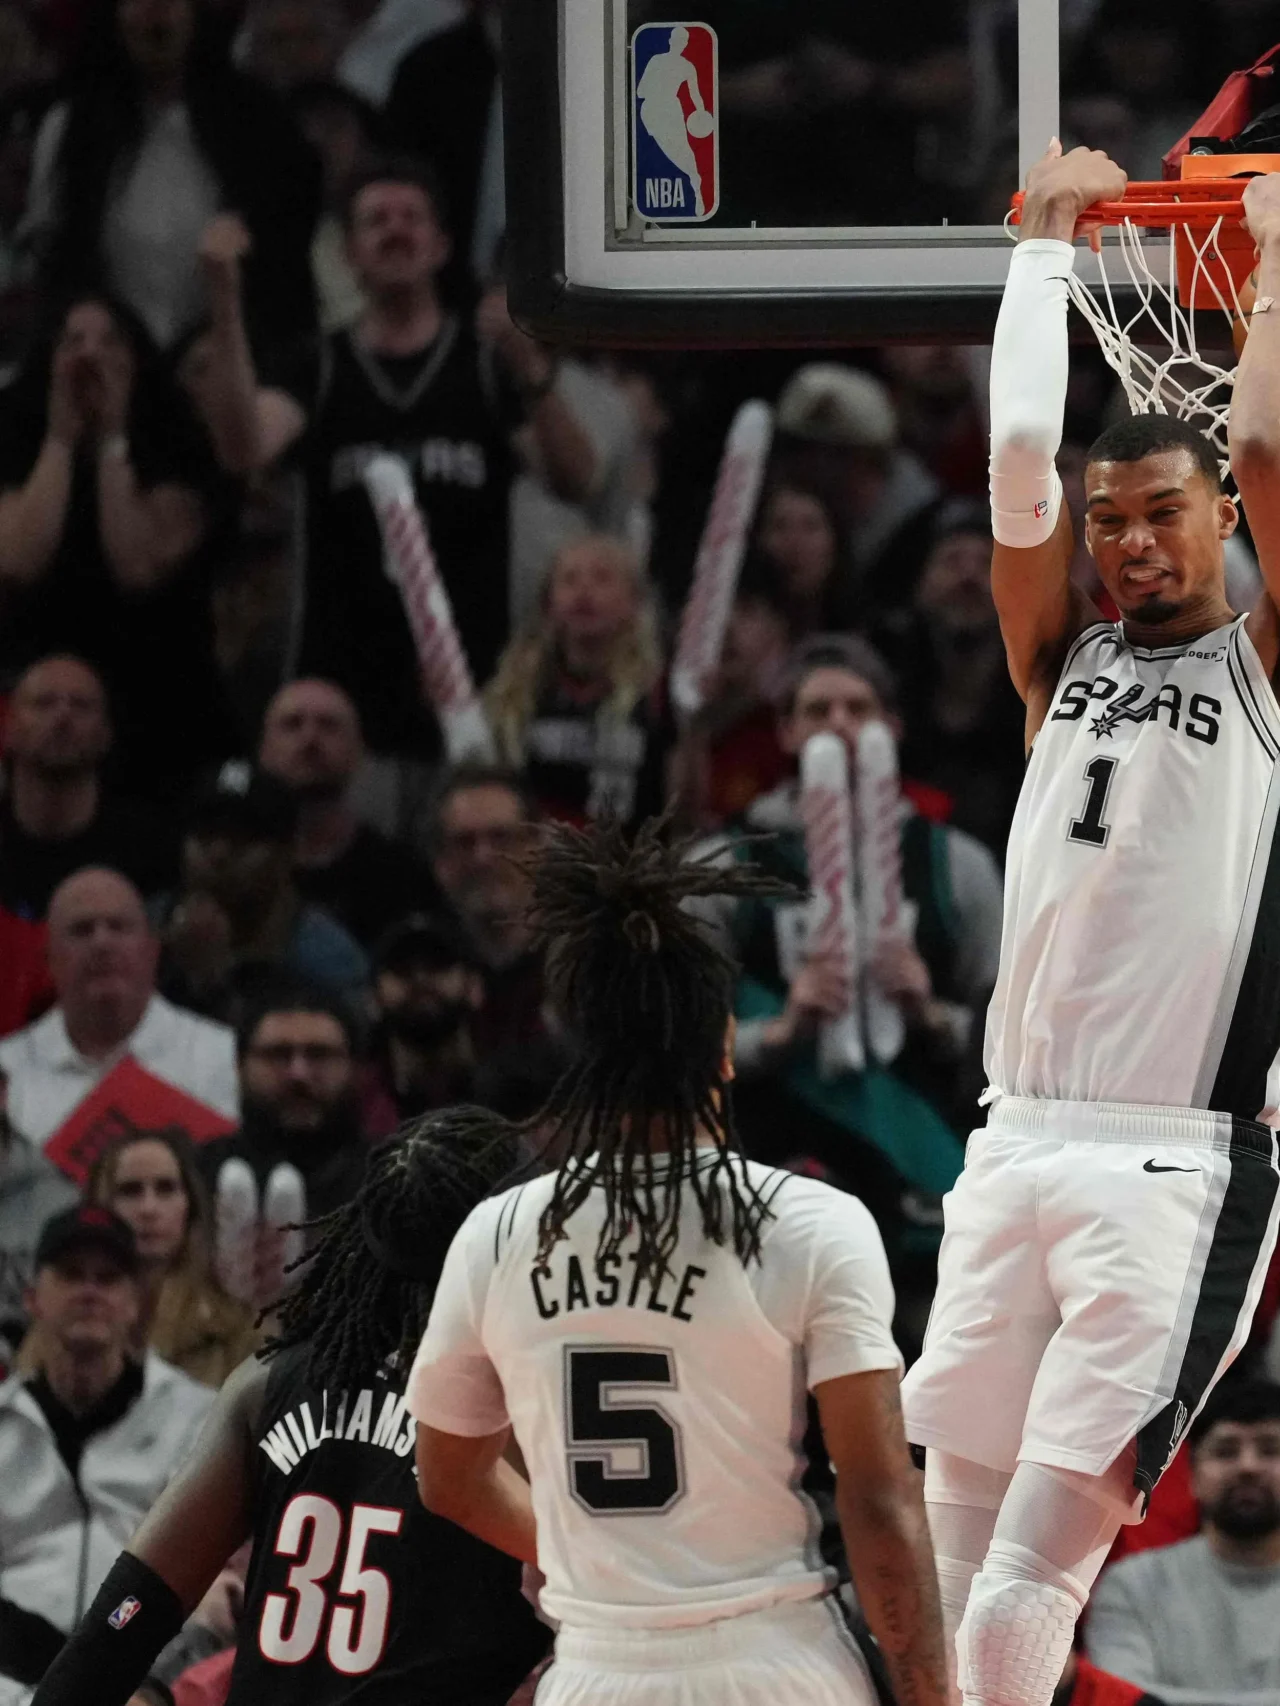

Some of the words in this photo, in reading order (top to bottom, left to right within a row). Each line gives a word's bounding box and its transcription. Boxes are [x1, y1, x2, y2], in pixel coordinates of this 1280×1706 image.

[645, 177, 685, 208] NBA
[1051, 675, 1222, 746] SPURS
[1065, 754, 1120, 850] 1
[530, 1253, 706, 1323] CASTLE
[258, 1388, 418, 1476] WILLIAMS
[563, 1342, 689, 1518] 5
[258, 1490, 405, 1677] 35
